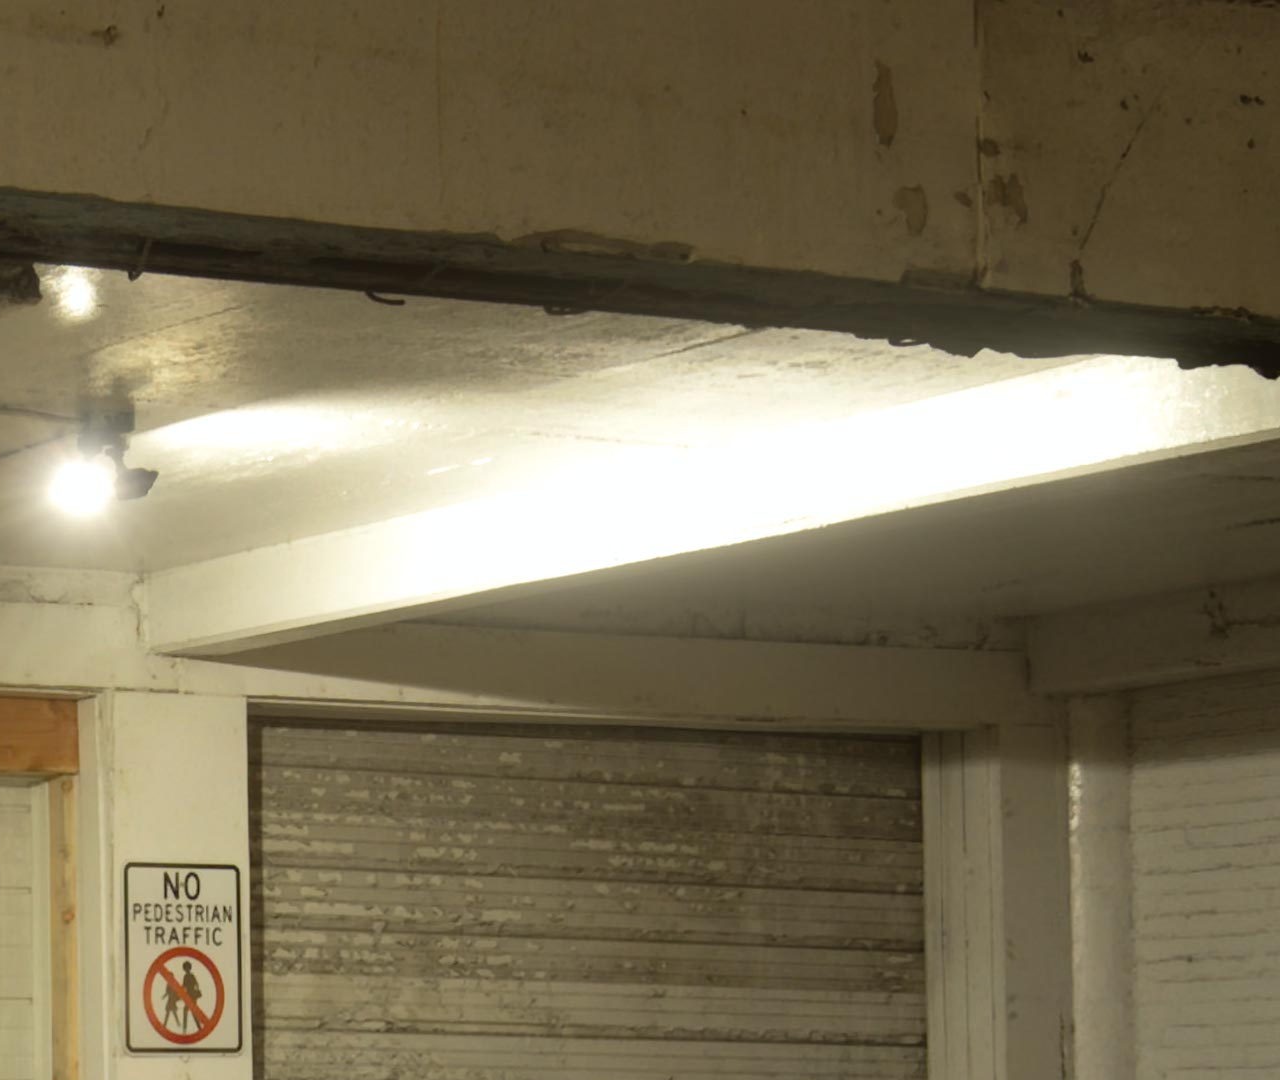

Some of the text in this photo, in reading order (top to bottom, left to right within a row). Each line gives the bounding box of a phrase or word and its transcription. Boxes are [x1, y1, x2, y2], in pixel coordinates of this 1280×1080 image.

[163, 872, 201, 901] NO
[133, 903, 233, 923] PEDESTRIAN
[144, 926, 223, 946] TRAFFIC
